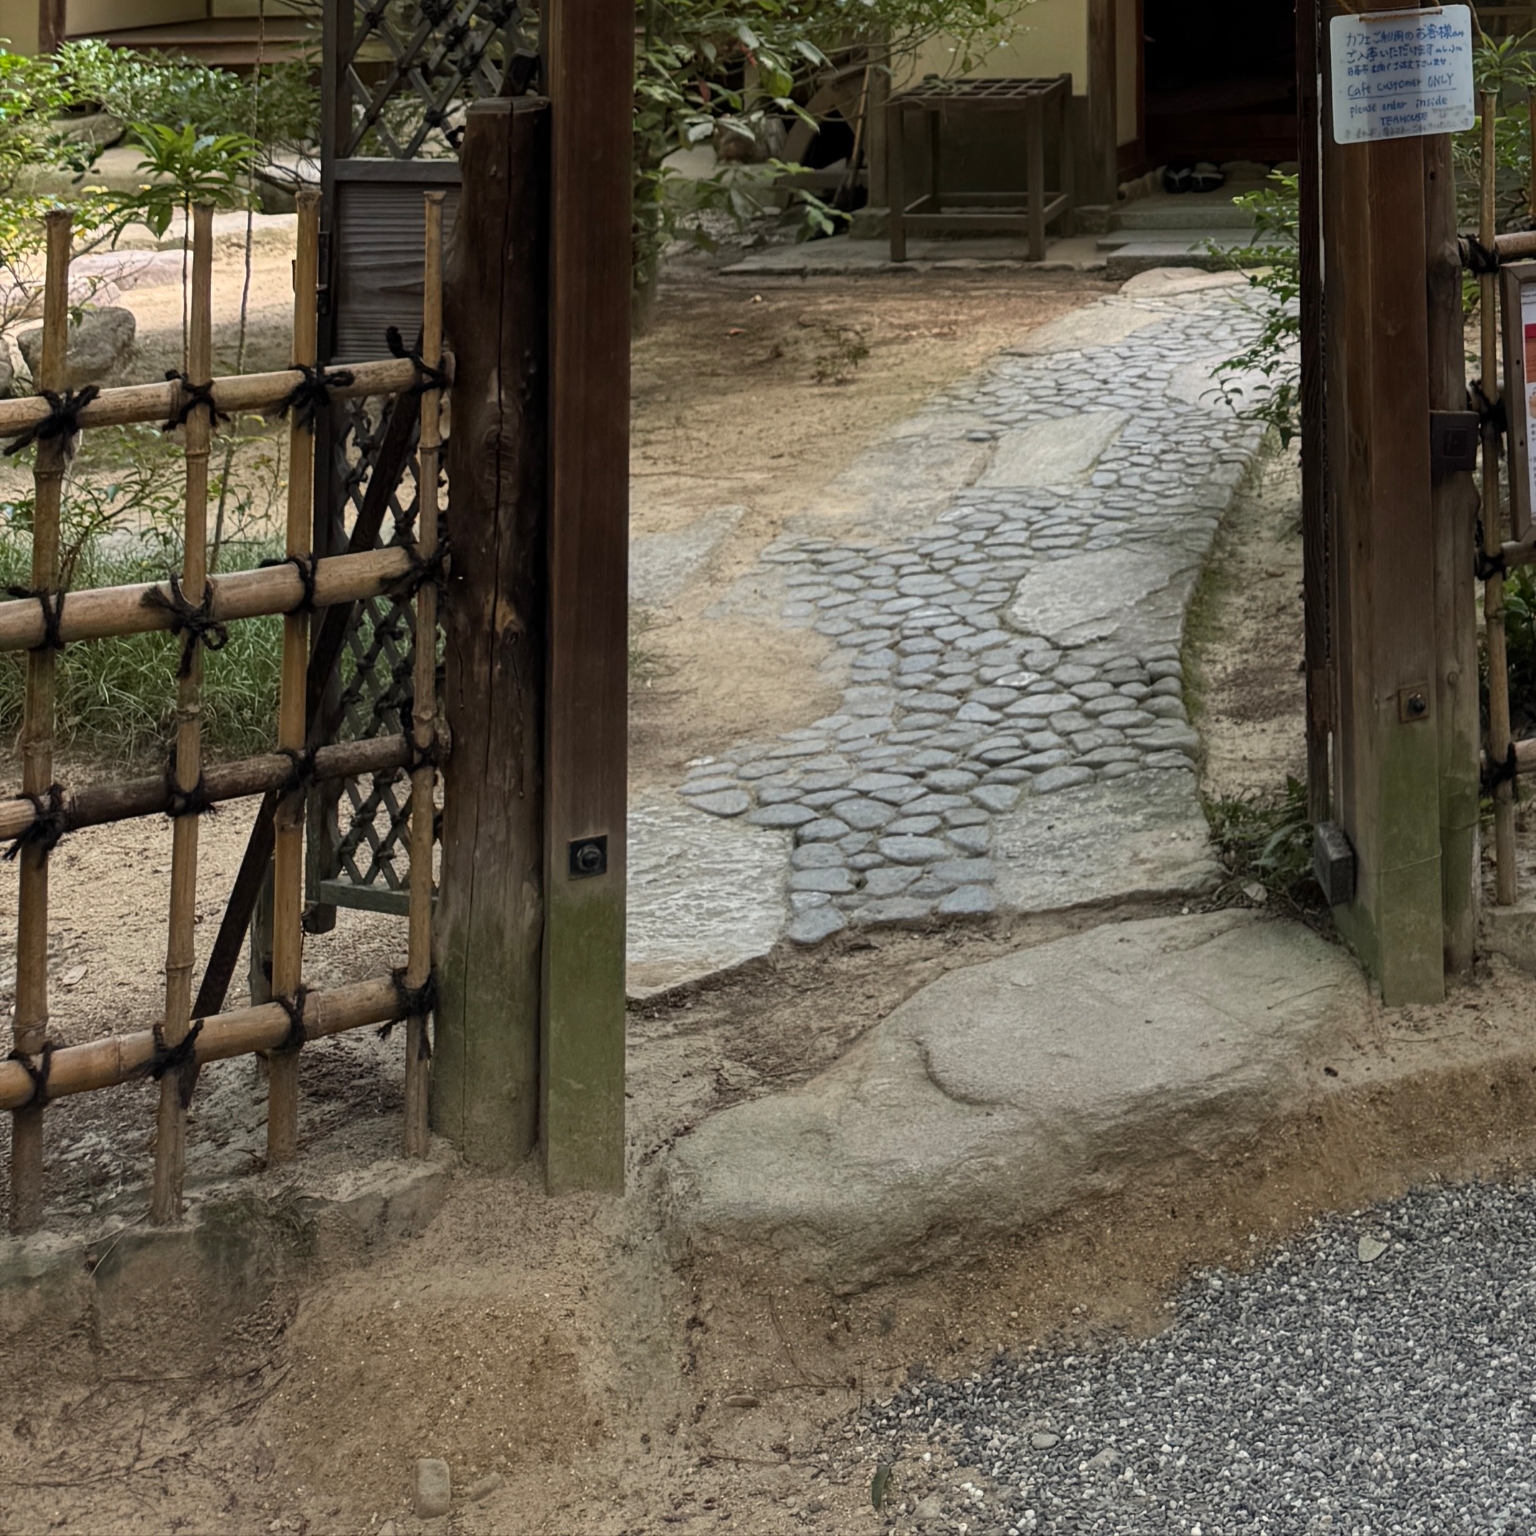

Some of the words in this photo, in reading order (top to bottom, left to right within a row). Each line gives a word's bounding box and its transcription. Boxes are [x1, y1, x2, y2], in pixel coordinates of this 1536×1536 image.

[1427, 73, 1455, 89] ONLY
[1349, 103, 1377, 119] please
[1382, 100, 1408, 112] order
[1416, 95, 1449, 109] inside
